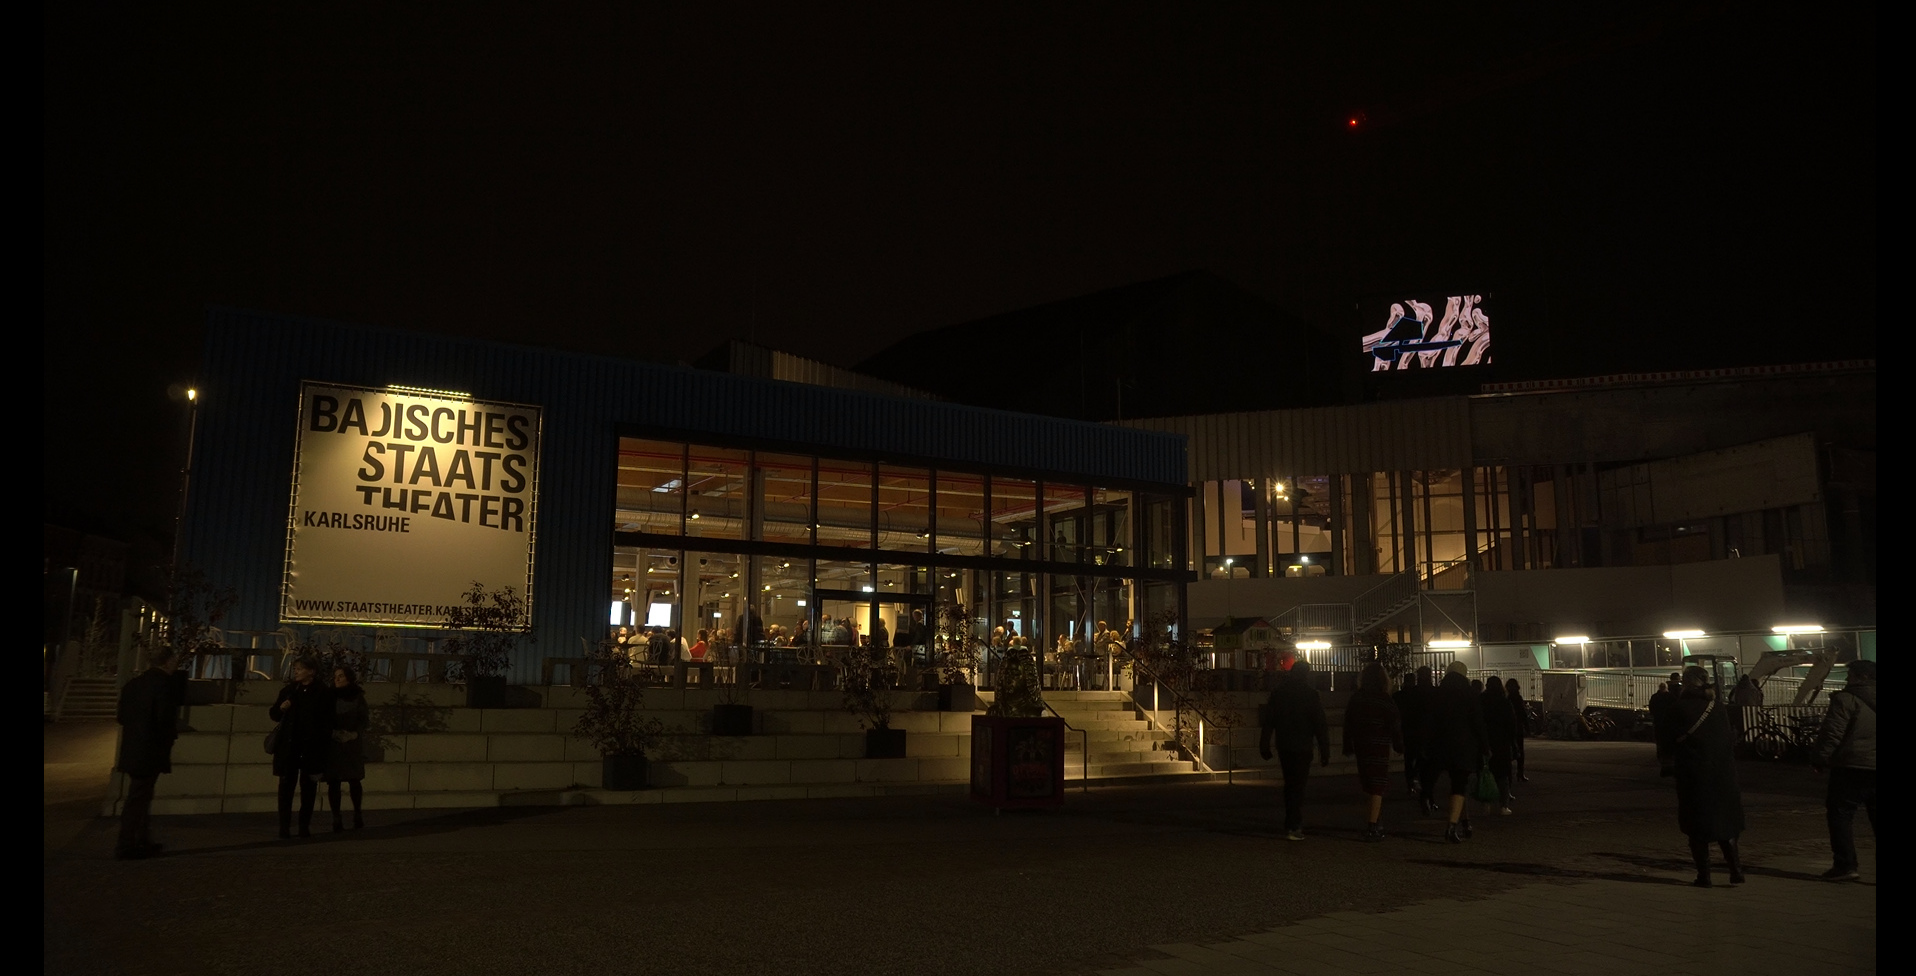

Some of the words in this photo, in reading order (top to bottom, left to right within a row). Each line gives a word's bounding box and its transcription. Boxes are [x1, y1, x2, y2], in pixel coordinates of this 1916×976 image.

[310, 394, 529, 451] BADISCHES
[357, 441, 526, 493] STAATS
[304, 510, 410, 533] KARLSRUHE
[356, 485, 524, 532] THEATER
